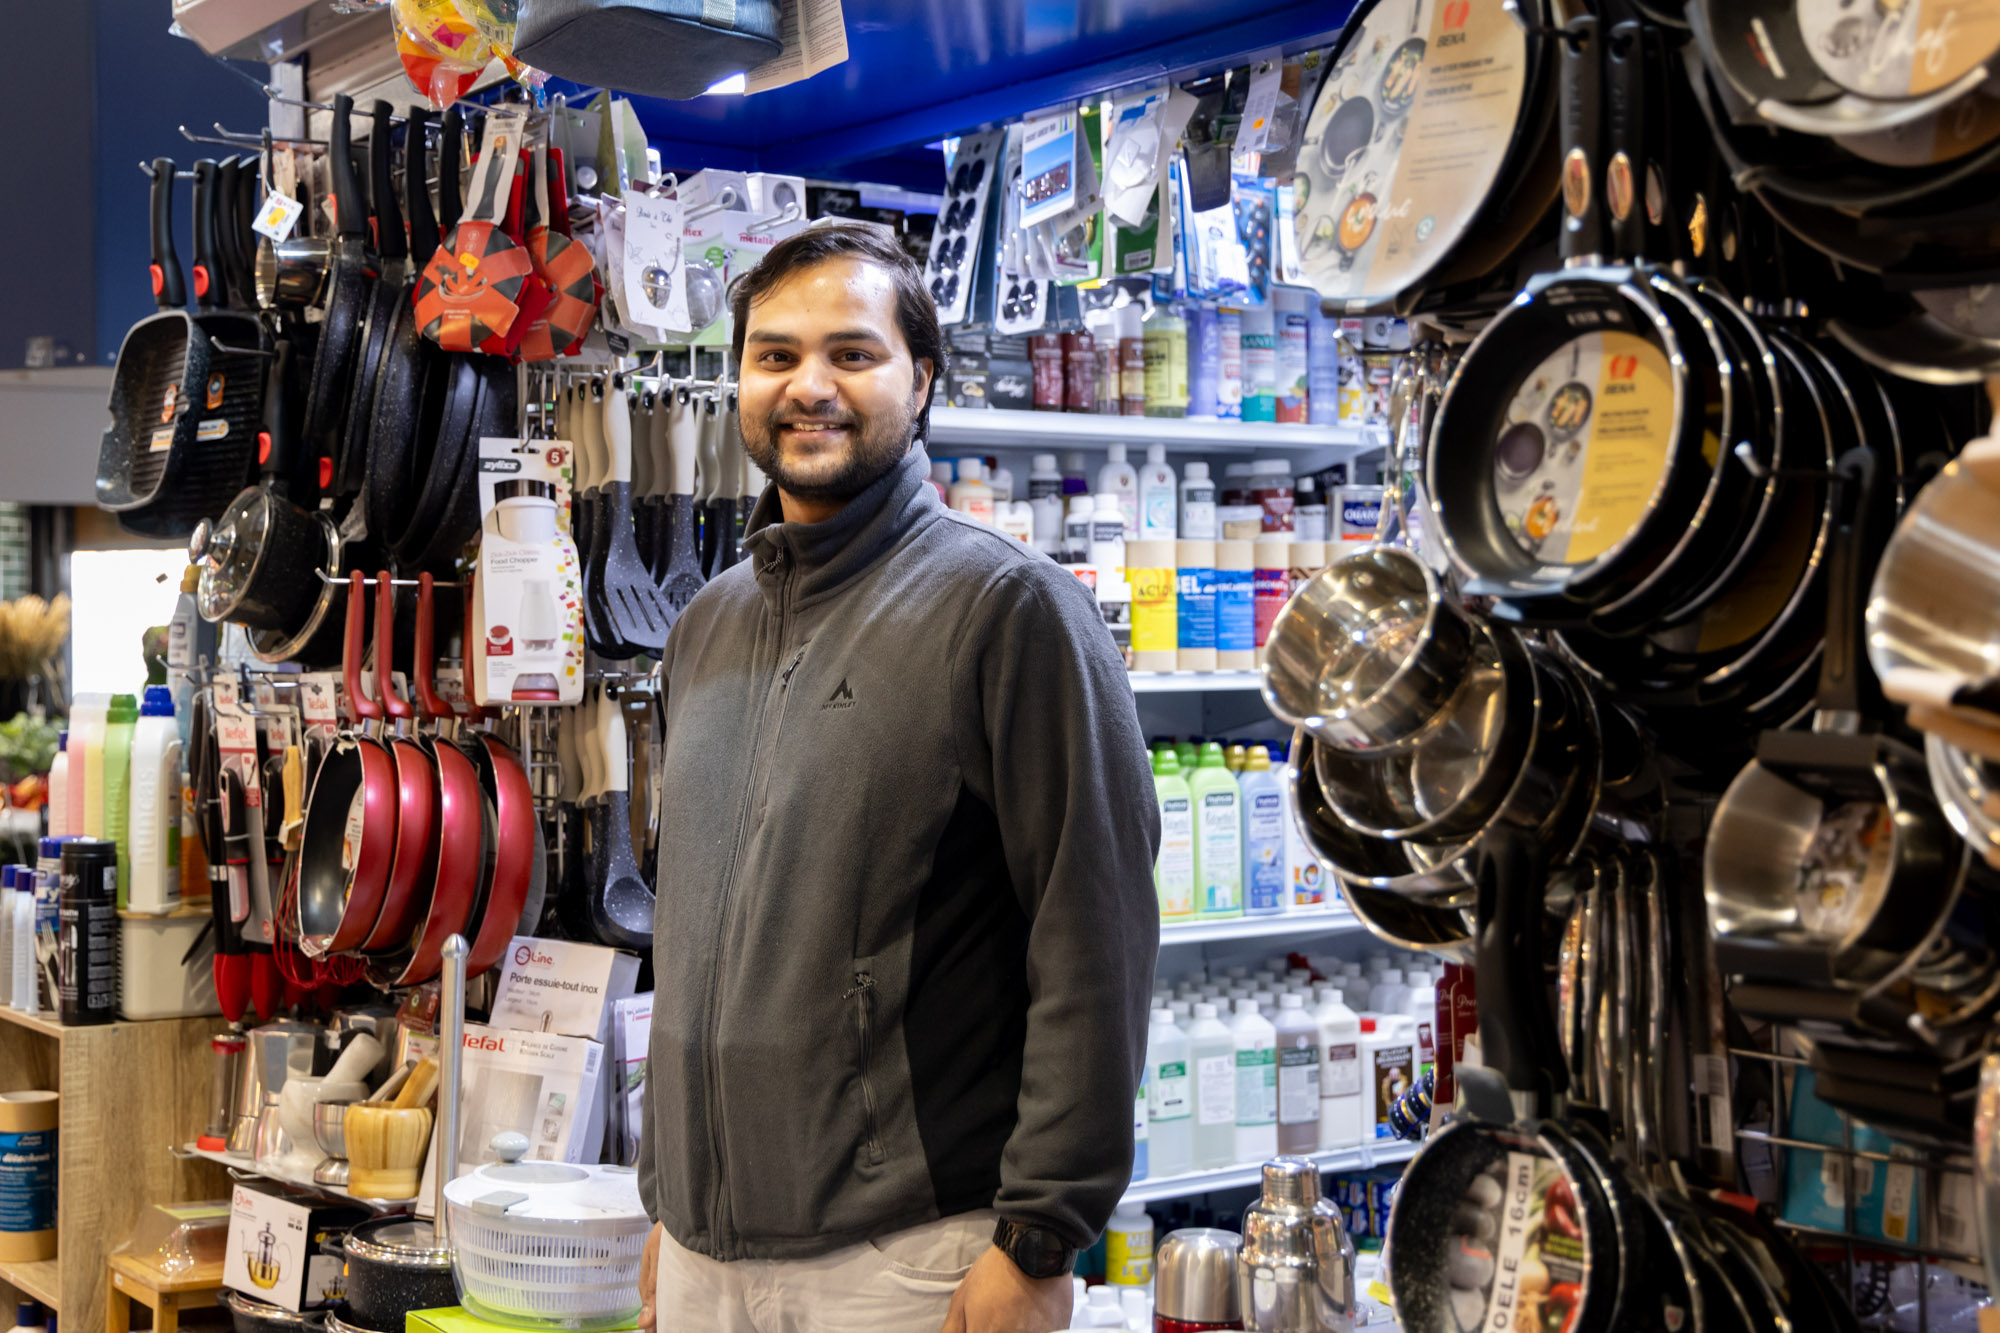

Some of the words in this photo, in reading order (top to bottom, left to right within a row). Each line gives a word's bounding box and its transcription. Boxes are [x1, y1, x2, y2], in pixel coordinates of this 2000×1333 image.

[551, 451, 560, 463] 5
[223, 728, 249, 740] Tefal
[510, 972, 533, 985] Porte
[580, 981, 599, 994] inox
[462, 1033, 505, 1053] Tefal
[1489, 1257, 1518, 1333] OELE
